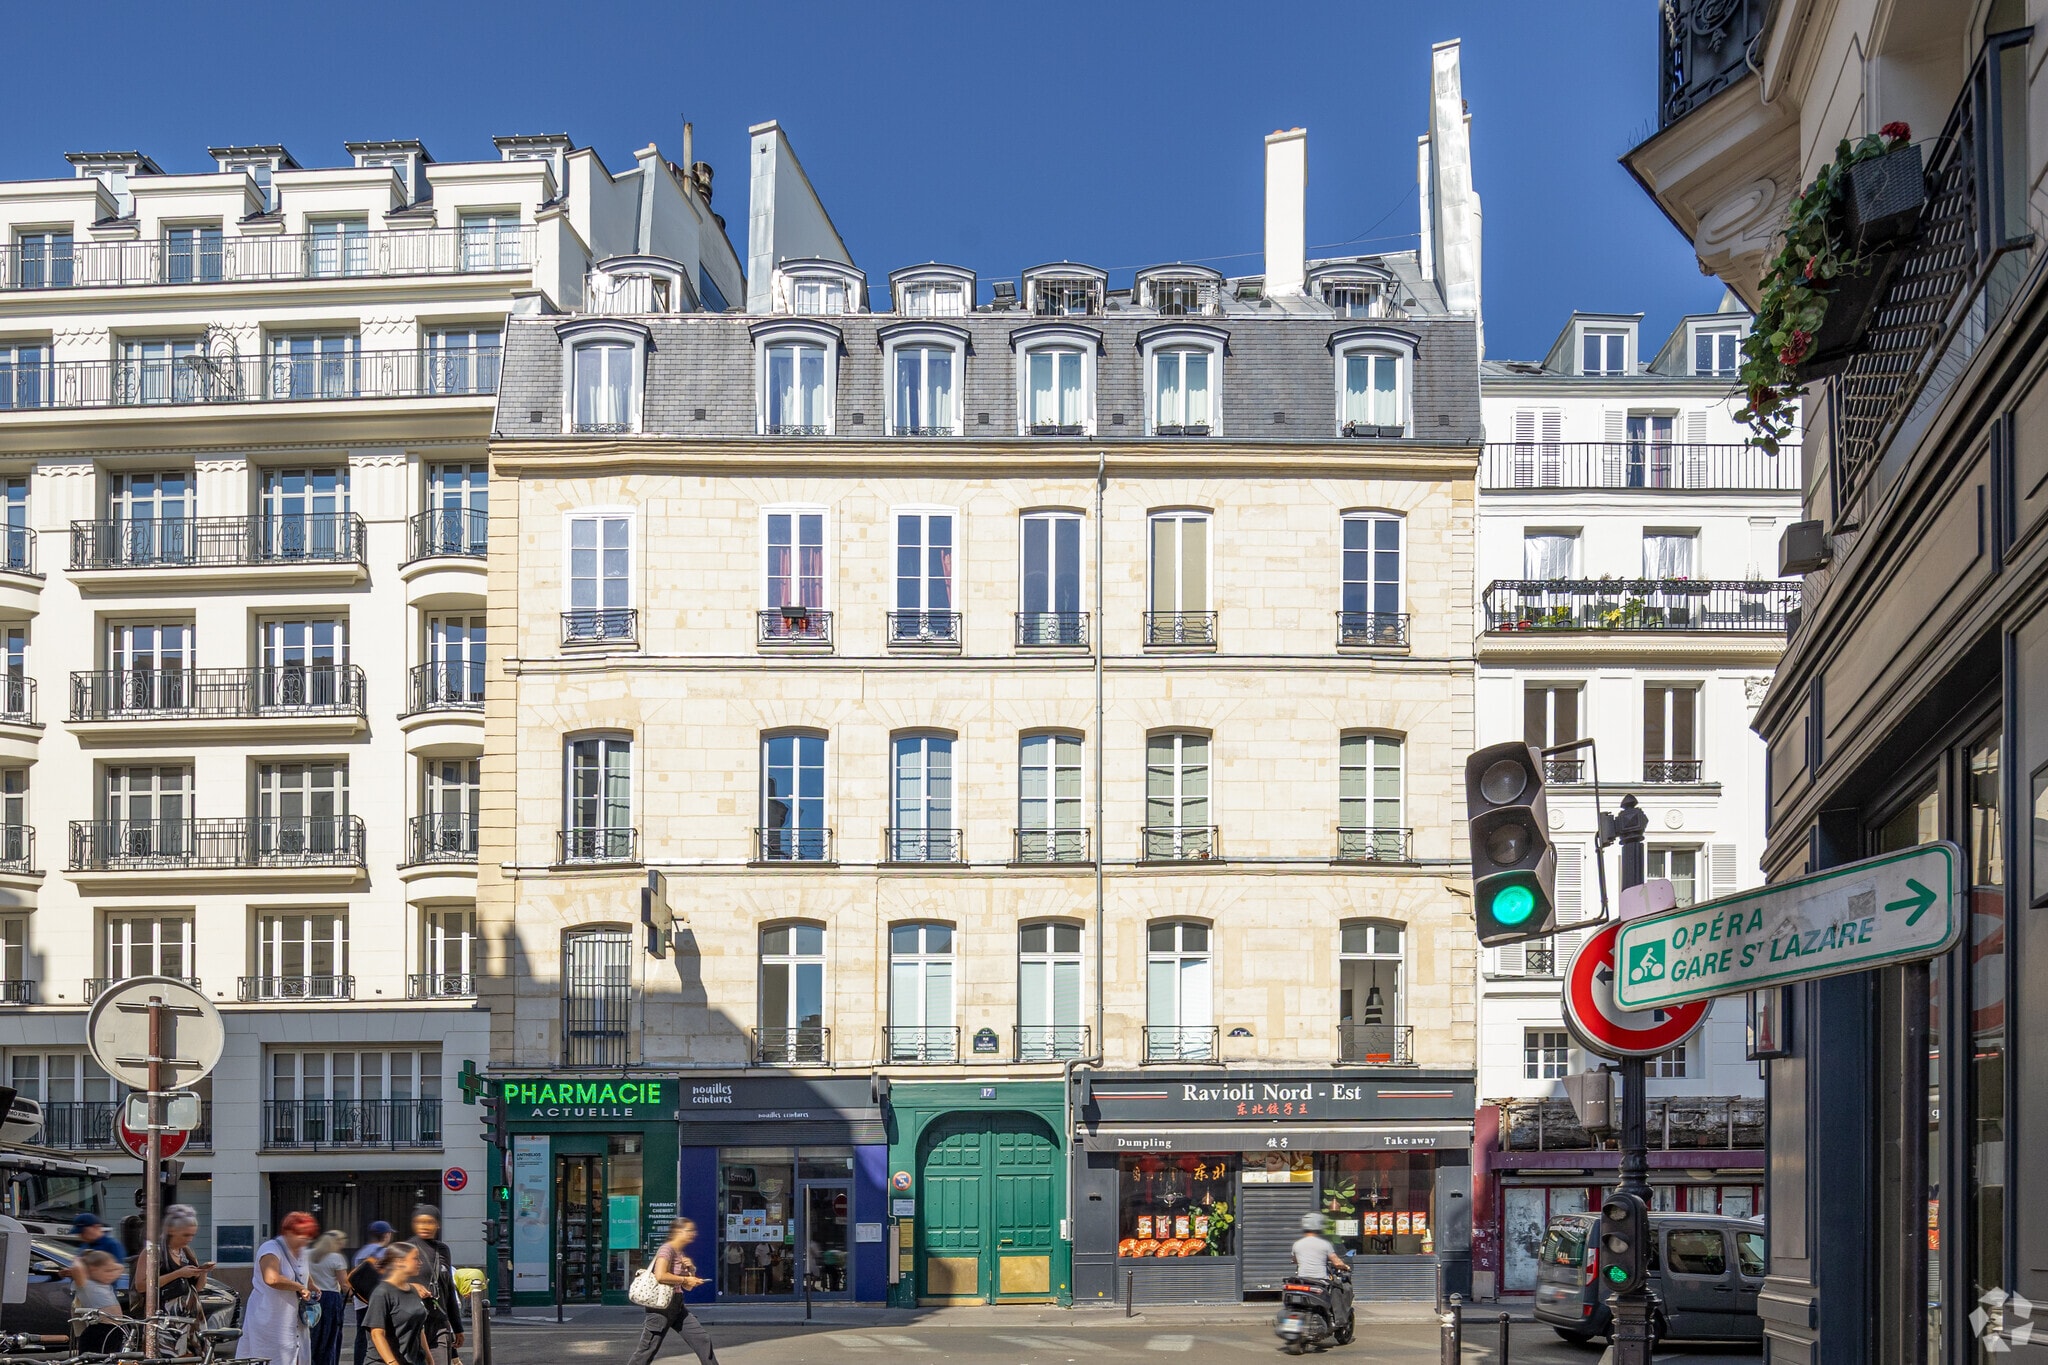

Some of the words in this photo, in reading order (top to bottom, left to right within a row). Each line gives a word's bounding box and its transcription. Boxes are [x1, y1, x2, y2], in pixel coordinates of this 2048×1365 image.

[1672, 908, 1763, 950] OPÉRA
[1670, 951, 1732, 983] GARE
[1769, 917, 1875, 963] LAZARE
[504, 1083, 661, 1105] PHARMACIE
[692, 1083, 732, 1095] nouilles
[983, 1088, 993, 1097] 17
[1182, 1083, 1255, 1101] Ravioli
[1262, 1083, 1313, 1101] Nord
[1331, 1083, 1362, 1101] Est
[692, 1095, 732, 1104] ceintures
[531, 1107, 633, 1117] ACTUELLE
[1117, 1138, 1172, 1149] Dumpling
[1266, 1137, 1289, 1148] 饺子
[1384, 1136, 1409, 1145] Take
[1411, 1137, 1436, 1147] away
